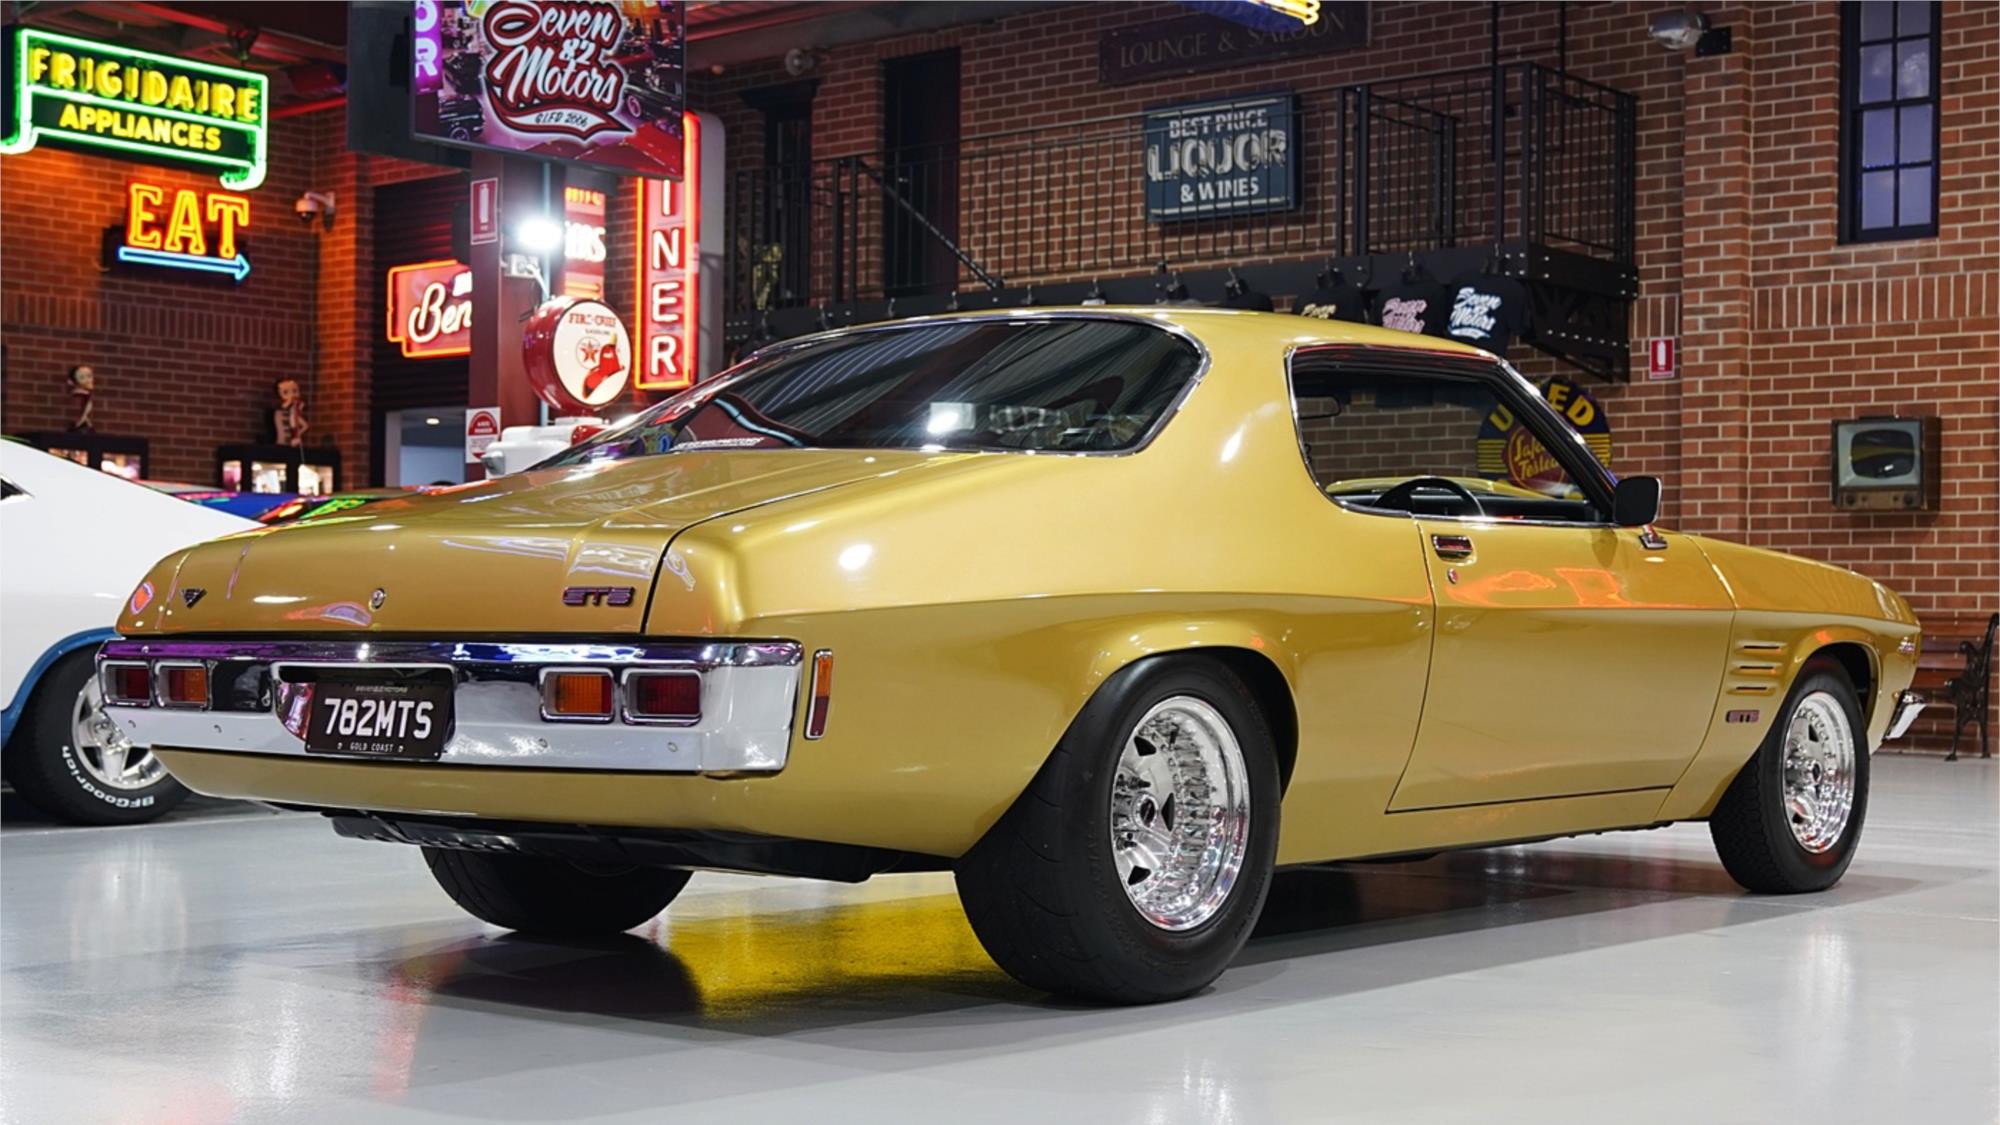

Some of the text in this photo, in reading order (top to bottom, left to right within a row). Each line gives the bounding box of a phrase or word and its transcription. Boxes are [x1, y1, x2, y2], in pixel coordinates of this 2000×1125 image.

[490, 0, 616, 46] Seven
[559, 38, 596, 65] 82
[1120, 33, 1208, 69] LOUNGE
[1217, 31, 1236, 52] &
[29, 47, 260, 122] FRIGIDAIRE
[493, 45, 618, 104] Motors
[59, 104, 222, 151] APPLIANCES
[1169, 108, 1268, 139] BEST PRICE
[1147, 129, 1286, 182] LIQUOR
[1181, 176, 1260, 203] & WINES
[128, 183, 249, 259] EAT
[324, 698, 434, 739] 782MTS
[350, 743, 394, 753] GOLD COAST
[62, 745, 155, 808] BFGoodrich
